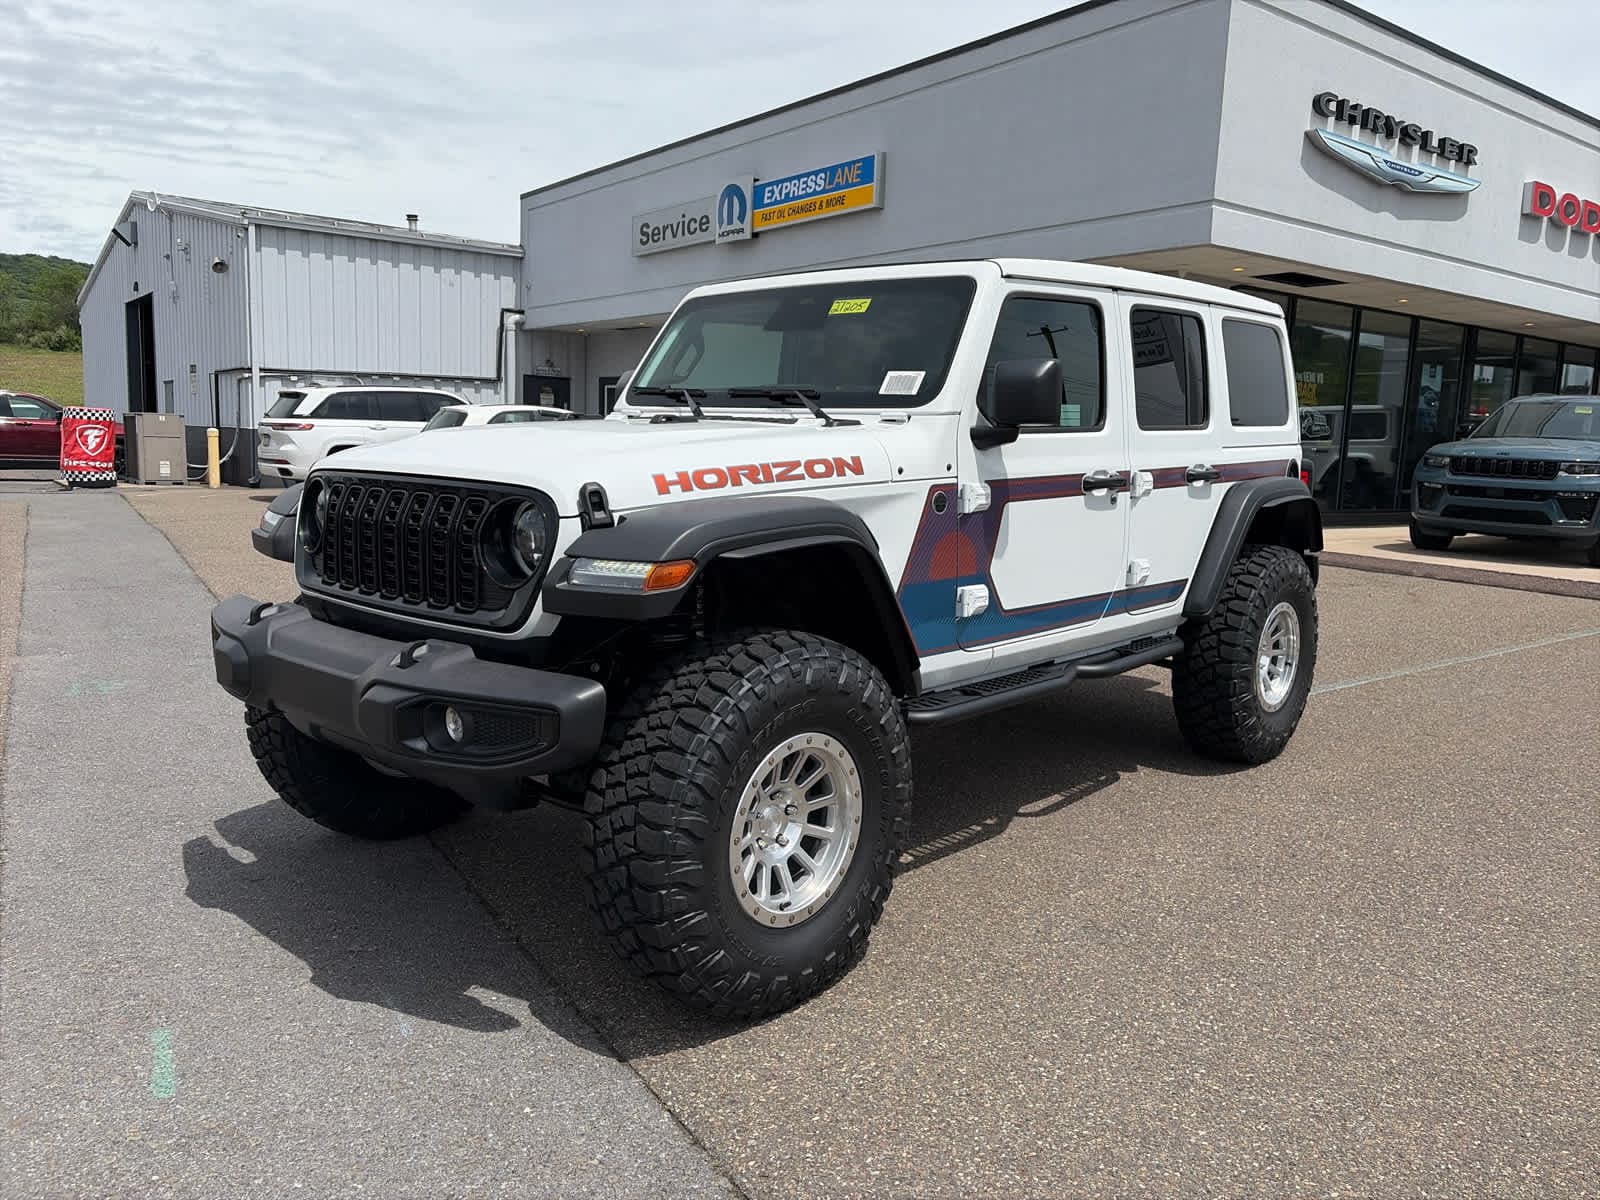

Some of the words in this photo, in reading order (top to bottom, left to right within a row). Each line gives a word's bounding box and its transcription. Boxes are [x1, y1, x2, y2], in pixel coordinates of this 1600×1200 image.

[1312, 91, 1479, 166] CHRYSLER
[761, 210, 776, 223] FAST
[776, 207, 786, 219] OIL
[787, 201, 817, 217] CHANGES
[818, 199, 824, 210] &
[825, 194, 847, 209] MORE
[639, 213, 711, 246] Service
[651, 455, 865, 495] HORIZON
